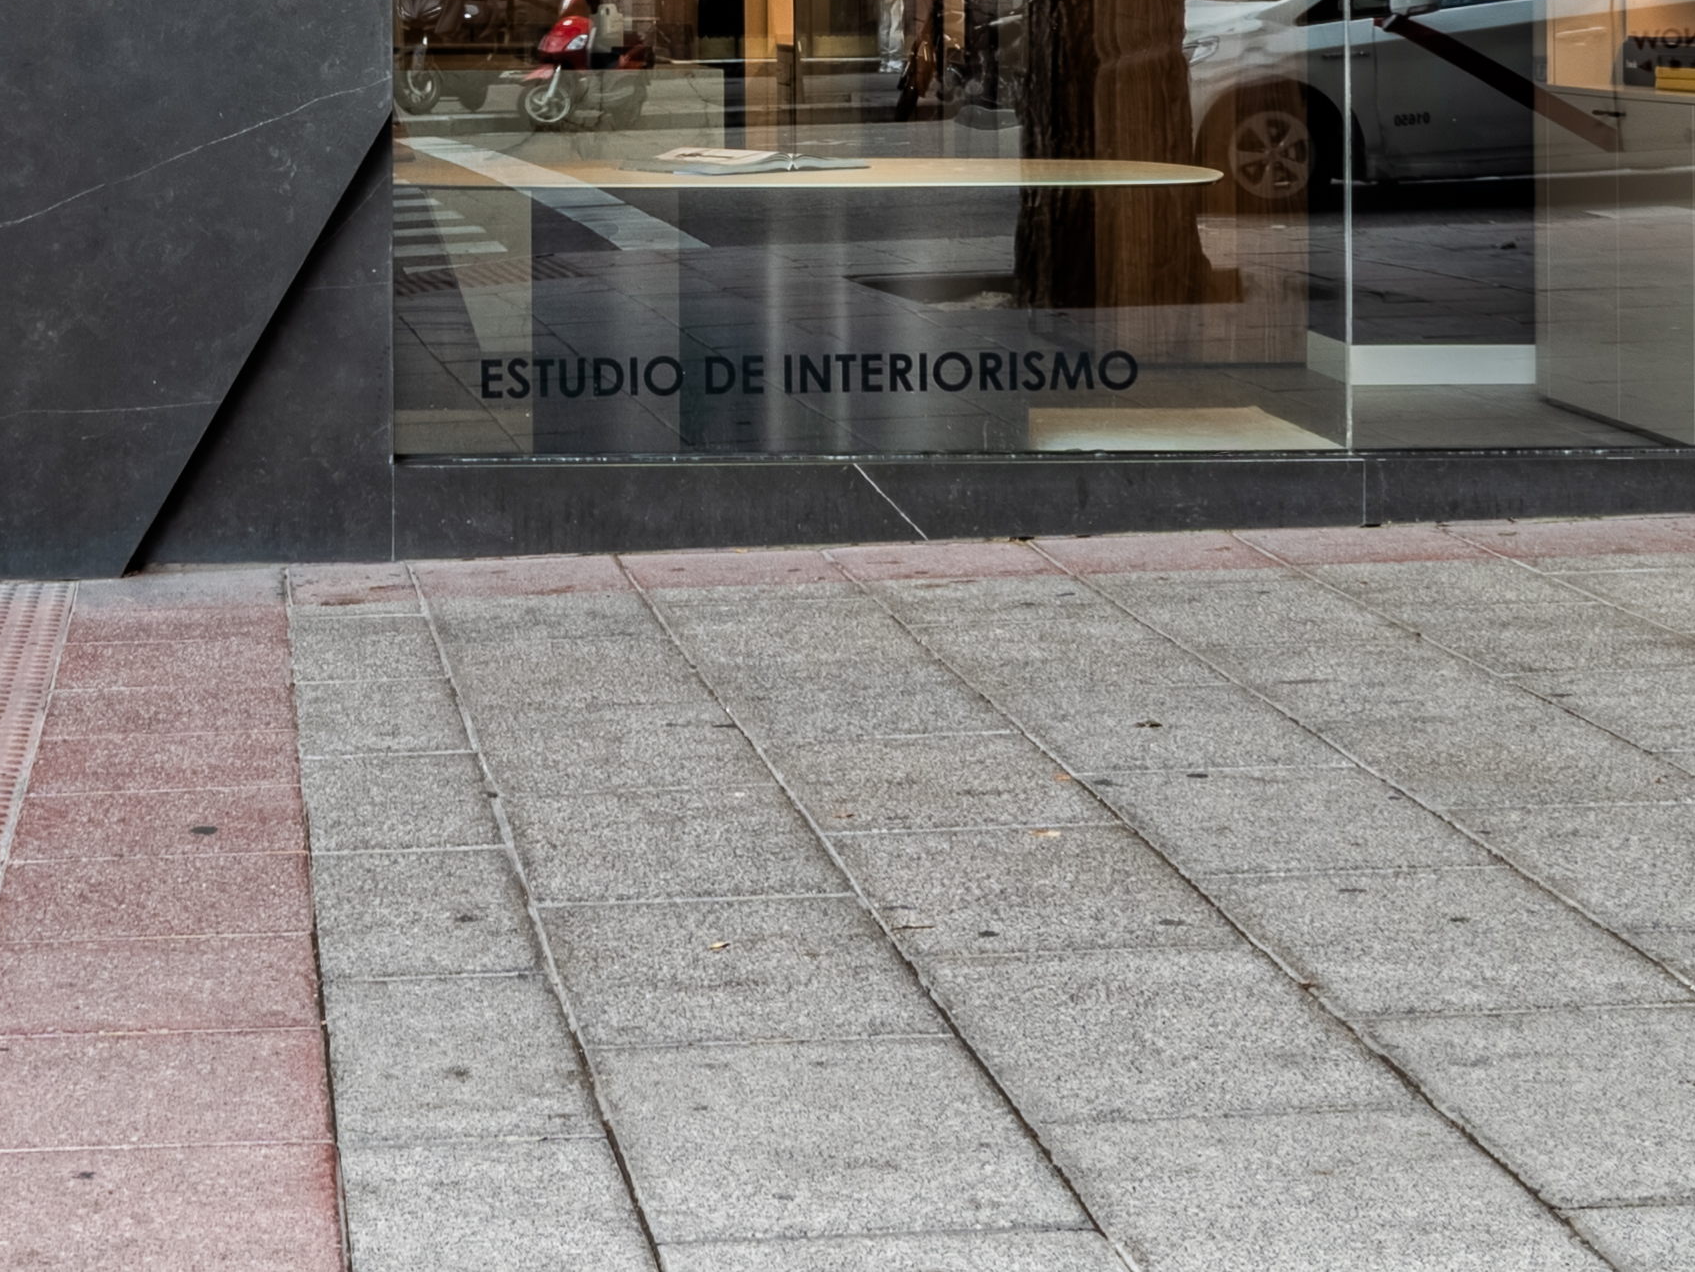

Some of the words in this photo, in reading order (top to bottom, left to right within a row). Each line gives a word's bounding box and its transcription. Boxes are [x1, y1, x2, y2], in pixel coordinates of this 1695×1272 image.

[480, 355, 685, 400] ESTUDIO
[704, 353, 766, 395] DE
[784, 348, 1139, 394] INTERIORISMO
